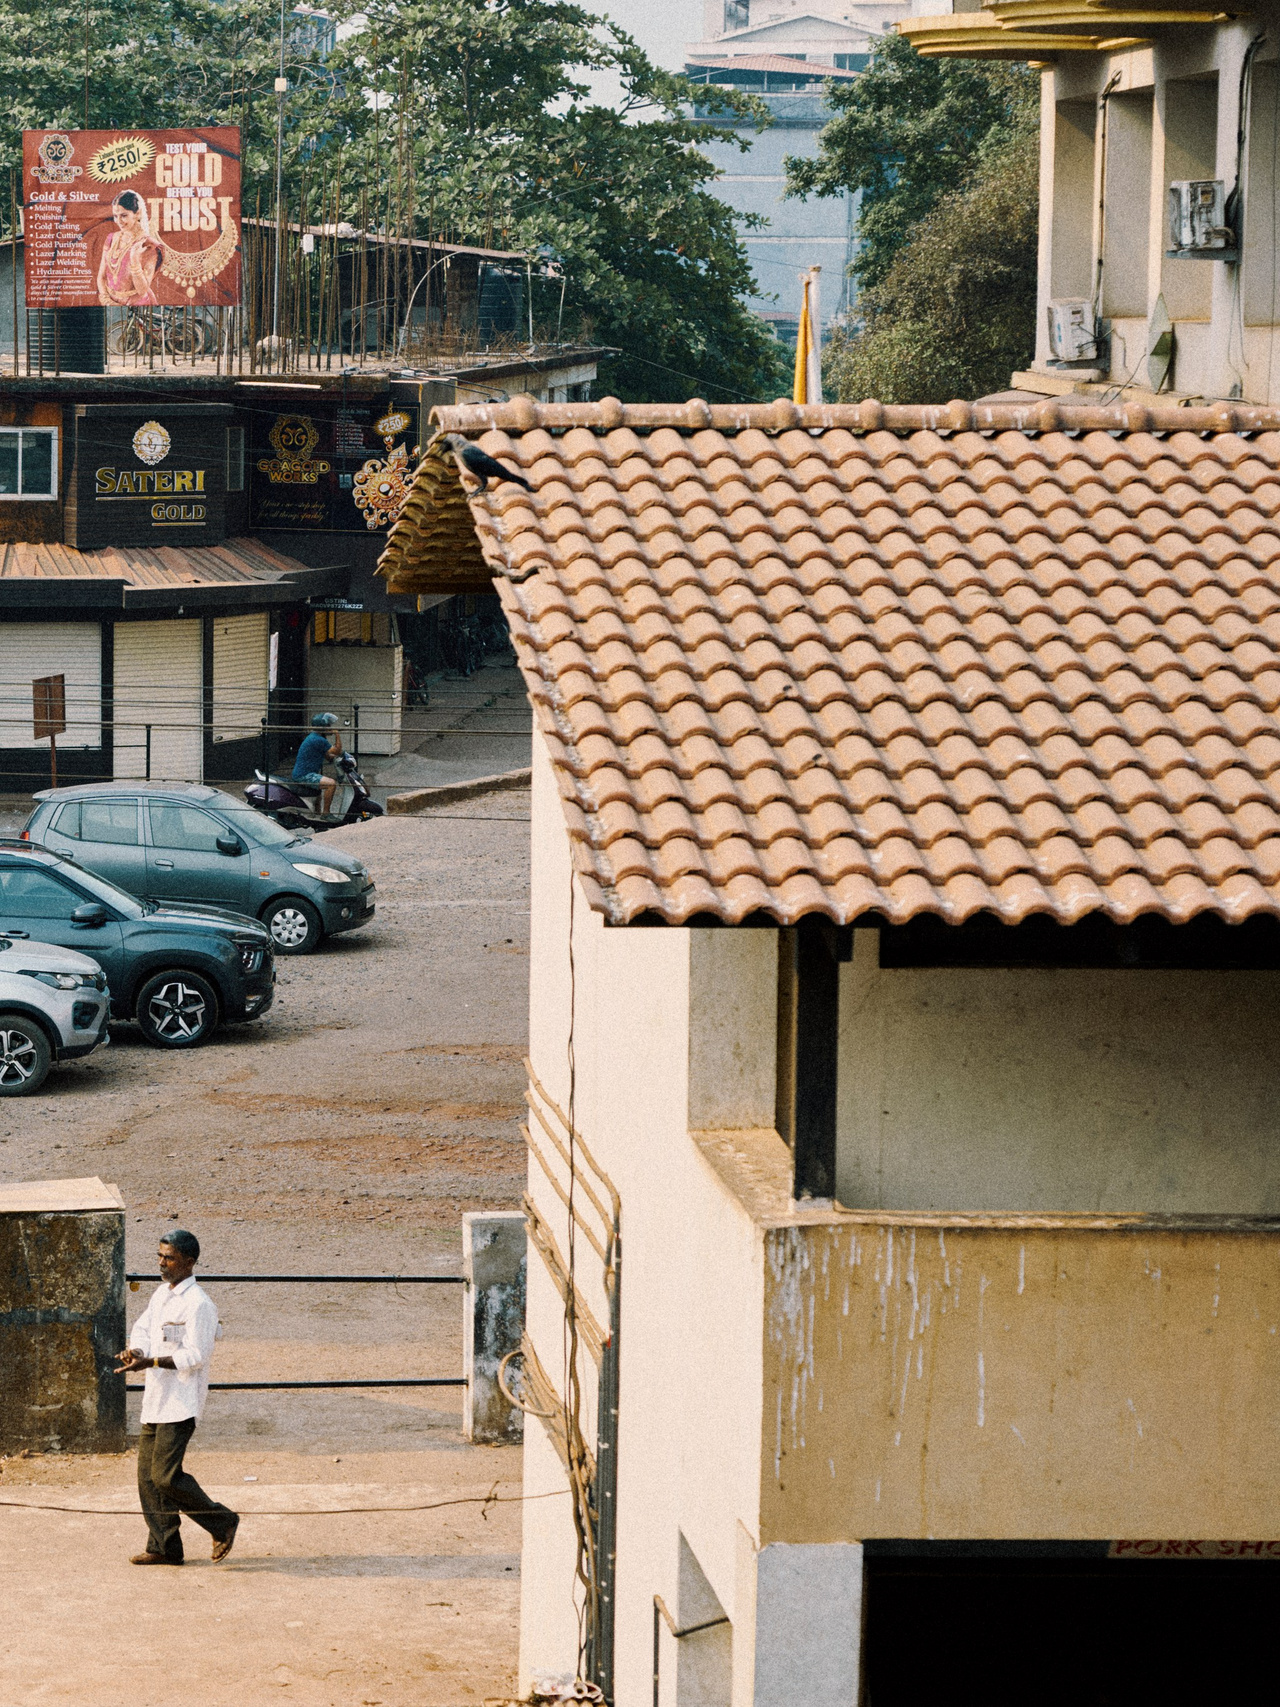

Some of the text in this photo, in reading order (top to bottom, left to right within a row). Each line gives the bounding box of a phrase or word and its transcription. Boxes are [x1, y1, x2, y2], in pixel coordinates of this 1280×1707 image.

[165, 142, 207, 153] TEST YOUR
[97, 148, 148, 174] ₹250/-
[156, 153, 222, 187] GOLD
[30, 192, 100, 200] Gold & Silver
[166, 186, 212, 197] BEFORE YOU
[34, 214, 67, 222] Polishing
[148, 196, 233, 232] TRUST
[56, 232, 82, 240] Cutting
[54, 241, 88, 250] Purifying
[56, 250, 87, 258] Marking
[36, 268, 72, 276] Hydraulic
[258, 460, 330, 472] GOAGOLD
[96, 466, 206, 493] SATERI
[269, 472, 317, 482] WORKS
[151, 503, 206, 520] GOLD
[1115, 1540, 1202, 1555] PORK
